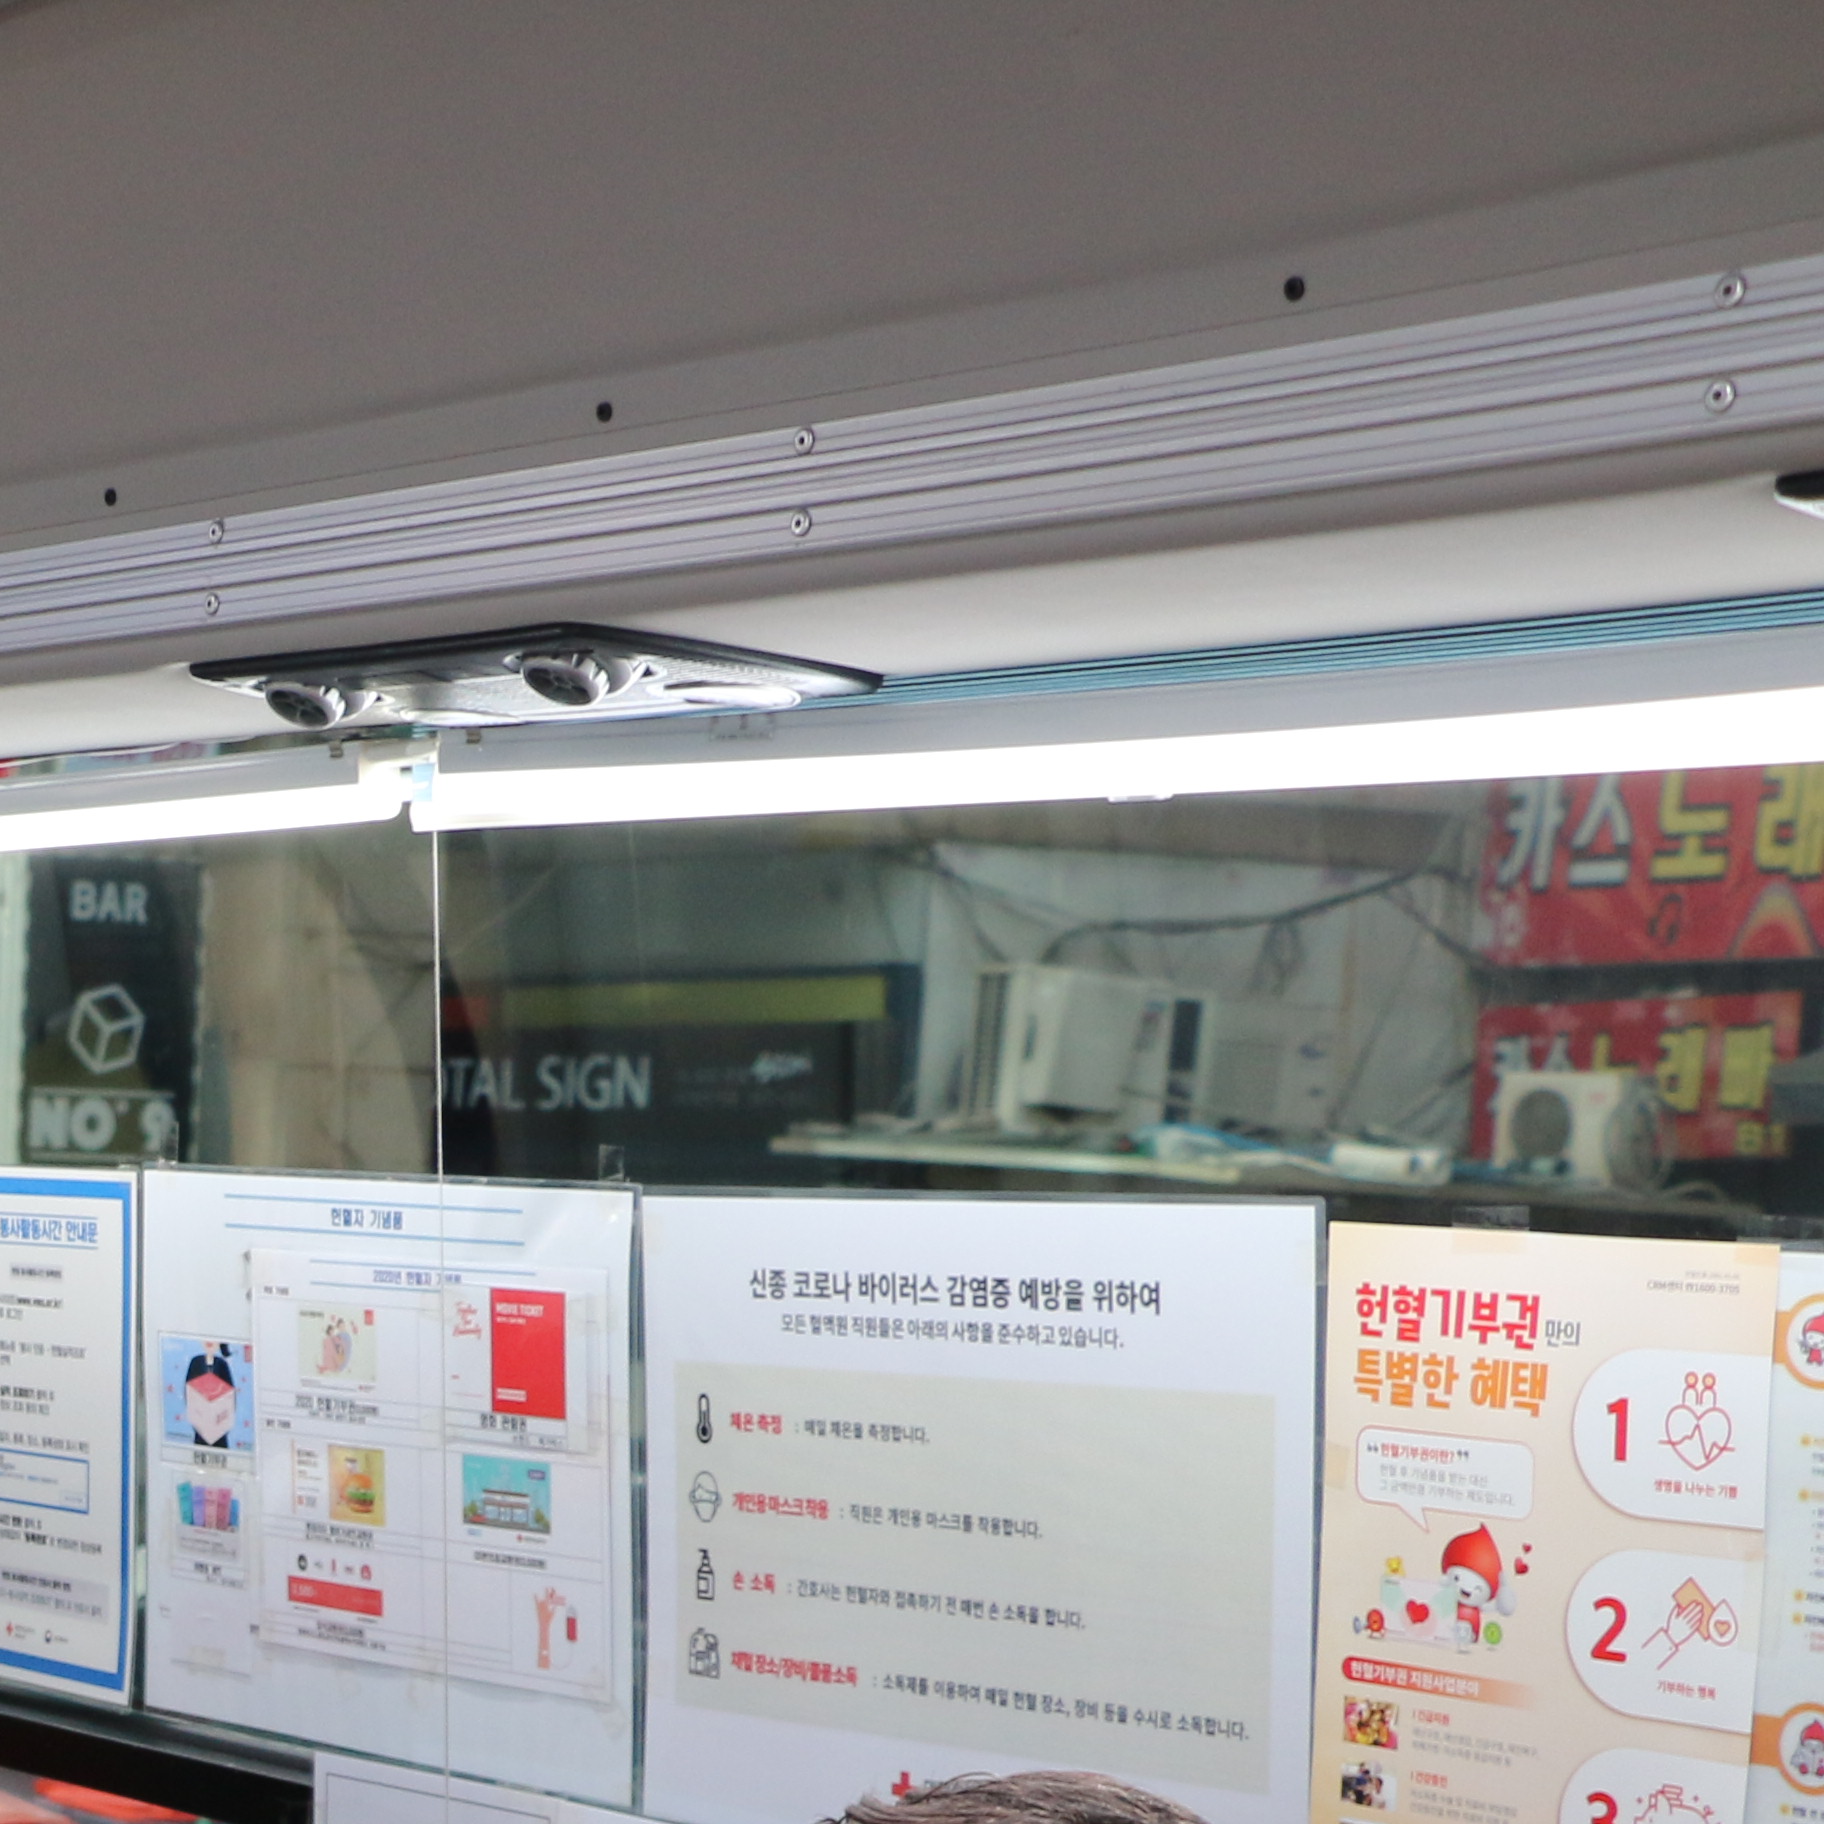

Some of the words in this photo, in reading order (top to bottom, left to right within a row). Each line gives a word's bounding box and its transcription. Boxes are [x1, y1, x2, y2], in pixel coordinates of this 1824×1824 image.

[69, 879, 148, 925] BAR
[442, 1057, 526, 1110] TAL
[536, 1055, 653, 1110] SIGN
[0, 1217, 62, 1241] 봉사활동시간
[65, 1221, 98, 1244] 안내문
[330, 1208, 365, 1229] 헌혈자
[370, 1209, 403, 1231] 기념품
[750, 1268, 786, 1300] 신종
[793, 1271, 851, 1303] 코로나
[858, 1272, 940, 1306] 바이러스
[946, 1275, 1011, 1309] 감염증
[1019, 1279, 1084, 1311] 예방을
[1092, 1280, 1161, 1315] 위하여
[782, 1314, 806, 1334] 모든
[809, 1315, 848, 1337] 혈액원
[851, 1316, 904, 1339] 직원들은
[907, 1319, 948, 1341] 아래의
[951, 1322, 993, 1344] 사항을
[997, 1325, 1056, 1346] 준수하고
[1059, 1327, 1125, 1349] 있습니다.
[1355, 1282, 1540, 1350] 헌혈기부권
[1545, 1319, 1581, 1347] 만의
[1354, 1347, 1459, 1409] 특별한
[1470, 1356, 1549, 1417] 혜택
[830, 1420, 863, 1439] 체온을
[868, 1423, 930, 1444] 측정합니다.
[1606, 1397, 1629, 1462] 1
[1685, 1482, 1715, 1498] 나누는
[1718, 1485, 1737, 1499] 기쁨
[850, 1503, 883, 1525] 직원은
[887, 1508, 921, 1528] 개인용
[926, 1513, 972, 1533] 마스크를
[978, 1516, 1043, 1538] 착용합니다.
[733, 1571, 744, 1590] 손
[750, 1573, 775, 1594] 소독
[798, 1579, 841, 1600] 간호사는
[846, 1585, 890, 1606] 헌혈자와
[988, 1602, 999, 1621] 손
[1004, 1605, 1038, 1624] 소독을
[1045, 1608, 1085, 1629] 합니다.
[1591, 1597, 1628, 1663] 2
[883, 1673, 928, 1696] 소독제를
[934, 1680, 981, 1703] 이용하여
[985, 1688, 1008, 1707] 매일
[1014, 1690, 1036, 1711] 헌혈
[1042, 1694, 1070, 1717] 장소,
[1074, 1700, 1098, 1719] 장비
[1104, 1703, 1128, 1723] 등을
[1134, 1708, 1172, 1729] 수시로
[1178, 1714, 1248, 1740] 소독합니다.
[1657, 1680, 1694, 1697] 기부하는
[1697, 1684, 1716, 1700] 행복
